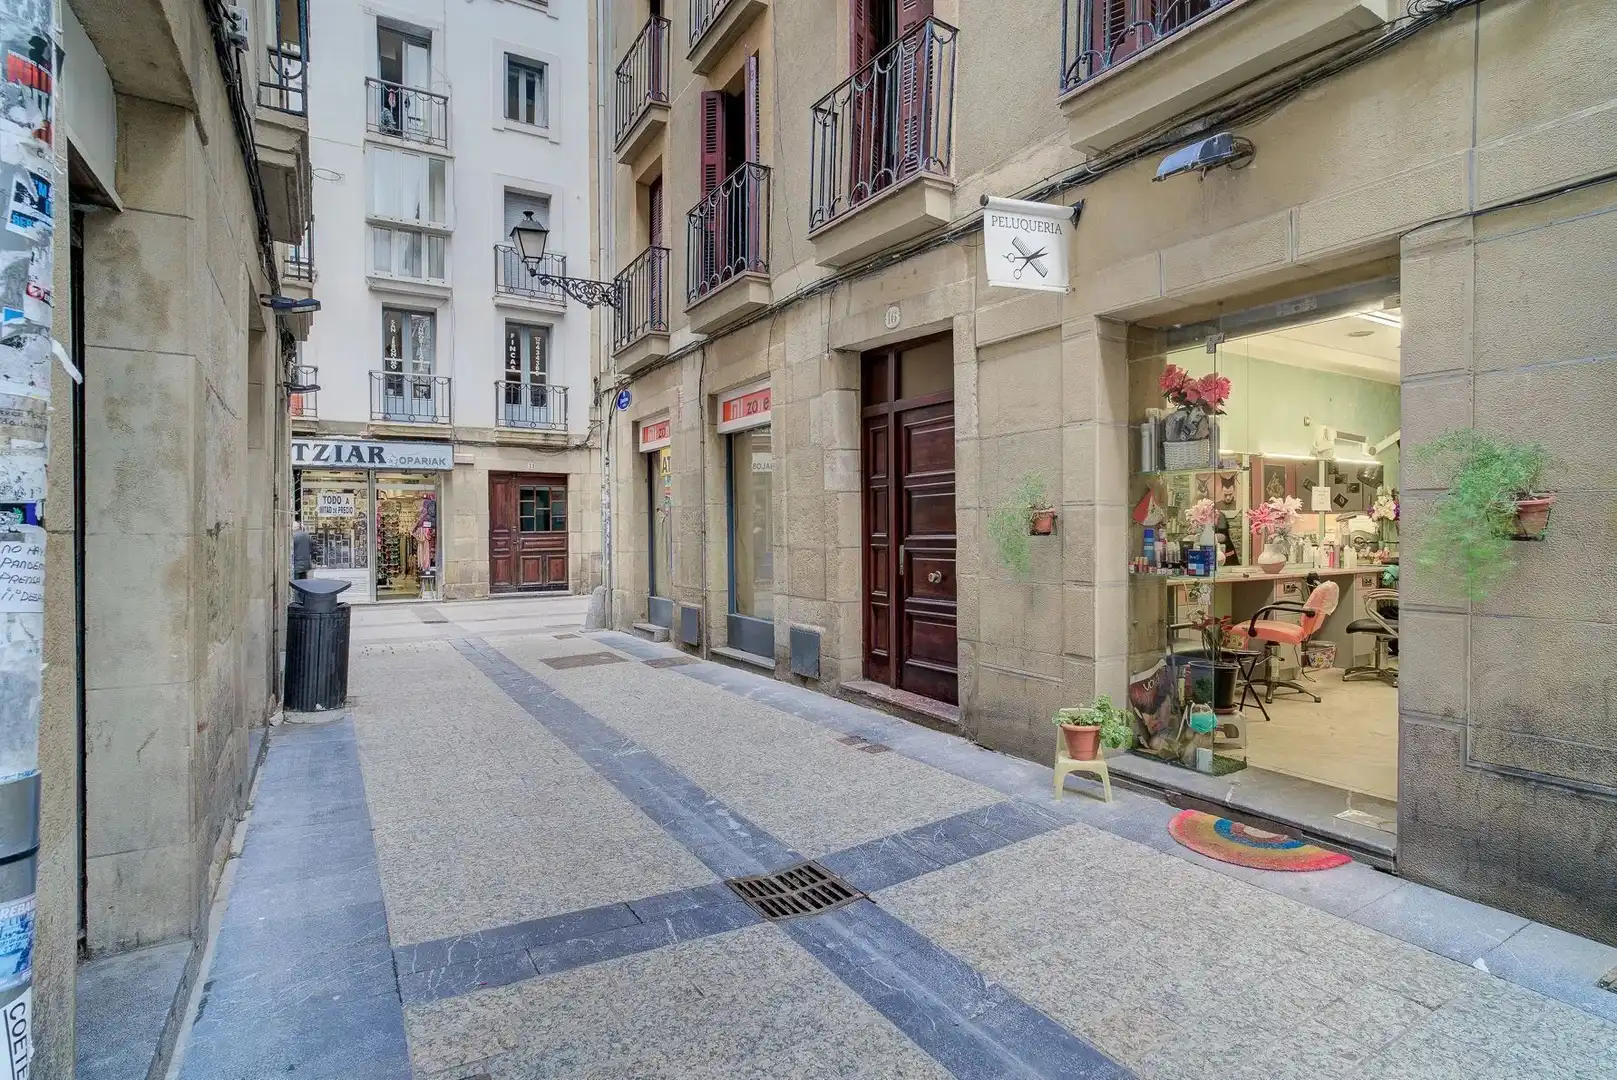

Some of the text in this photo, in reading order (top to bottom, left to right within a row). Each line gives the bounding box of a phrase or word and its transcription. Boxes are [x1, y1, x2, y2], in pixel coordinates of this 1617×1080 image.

[991, 215, 1063, 235] PELUQUERIA
[292, 442, 446, 466] TZIAR OPARIAK
[323, 495, 342, 505] TODO
